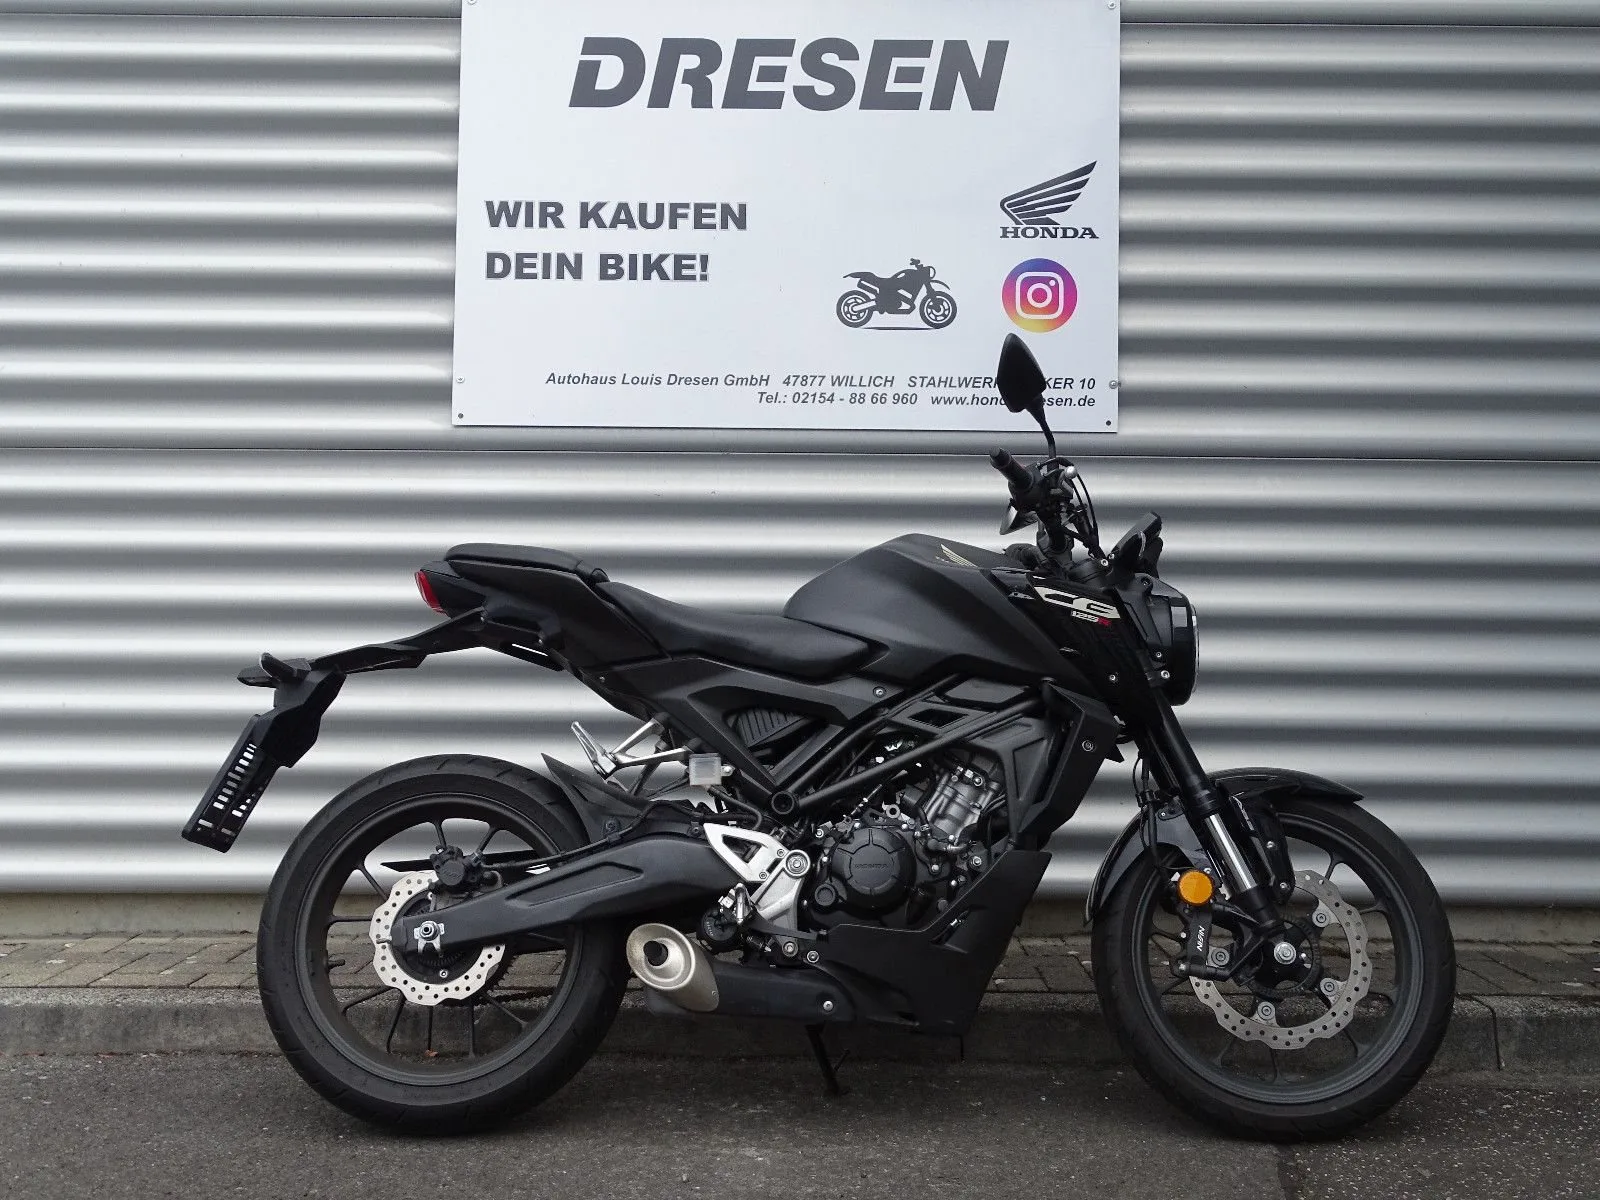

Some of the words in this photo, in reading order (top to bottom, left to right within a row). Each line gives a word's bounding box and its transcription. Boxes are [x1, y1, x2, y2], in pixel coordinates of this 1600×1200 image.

[569, 37, 1010, 111] DRESEN
[485, 200, 565, 228] WIR
[579, 201, 747, 230] KAUFEN
[999, 226, 1100, 239] HONDA
[486, 252, 583, 280] DEIN
[599, 253, 709, 281] BIKE!
[545, 373, 616, 385] Autohaus
[621, 373, 662, 386] Louis
[666, 374, 719, 386] Dresen
[723, 374, 770, 387] GmbH
[783, 374, 826, 387] 47877
[831, 375, 895, 388] WILLICH
[1079, 378, 1096, 390] 10
[757, 391, 787, 404] Tel.:
[792, 392, 835, 404] 02154
[849, 393, 866, 405] 88
[870, 393, 888, 405] 66
[892, 393, 918, 405] 960
